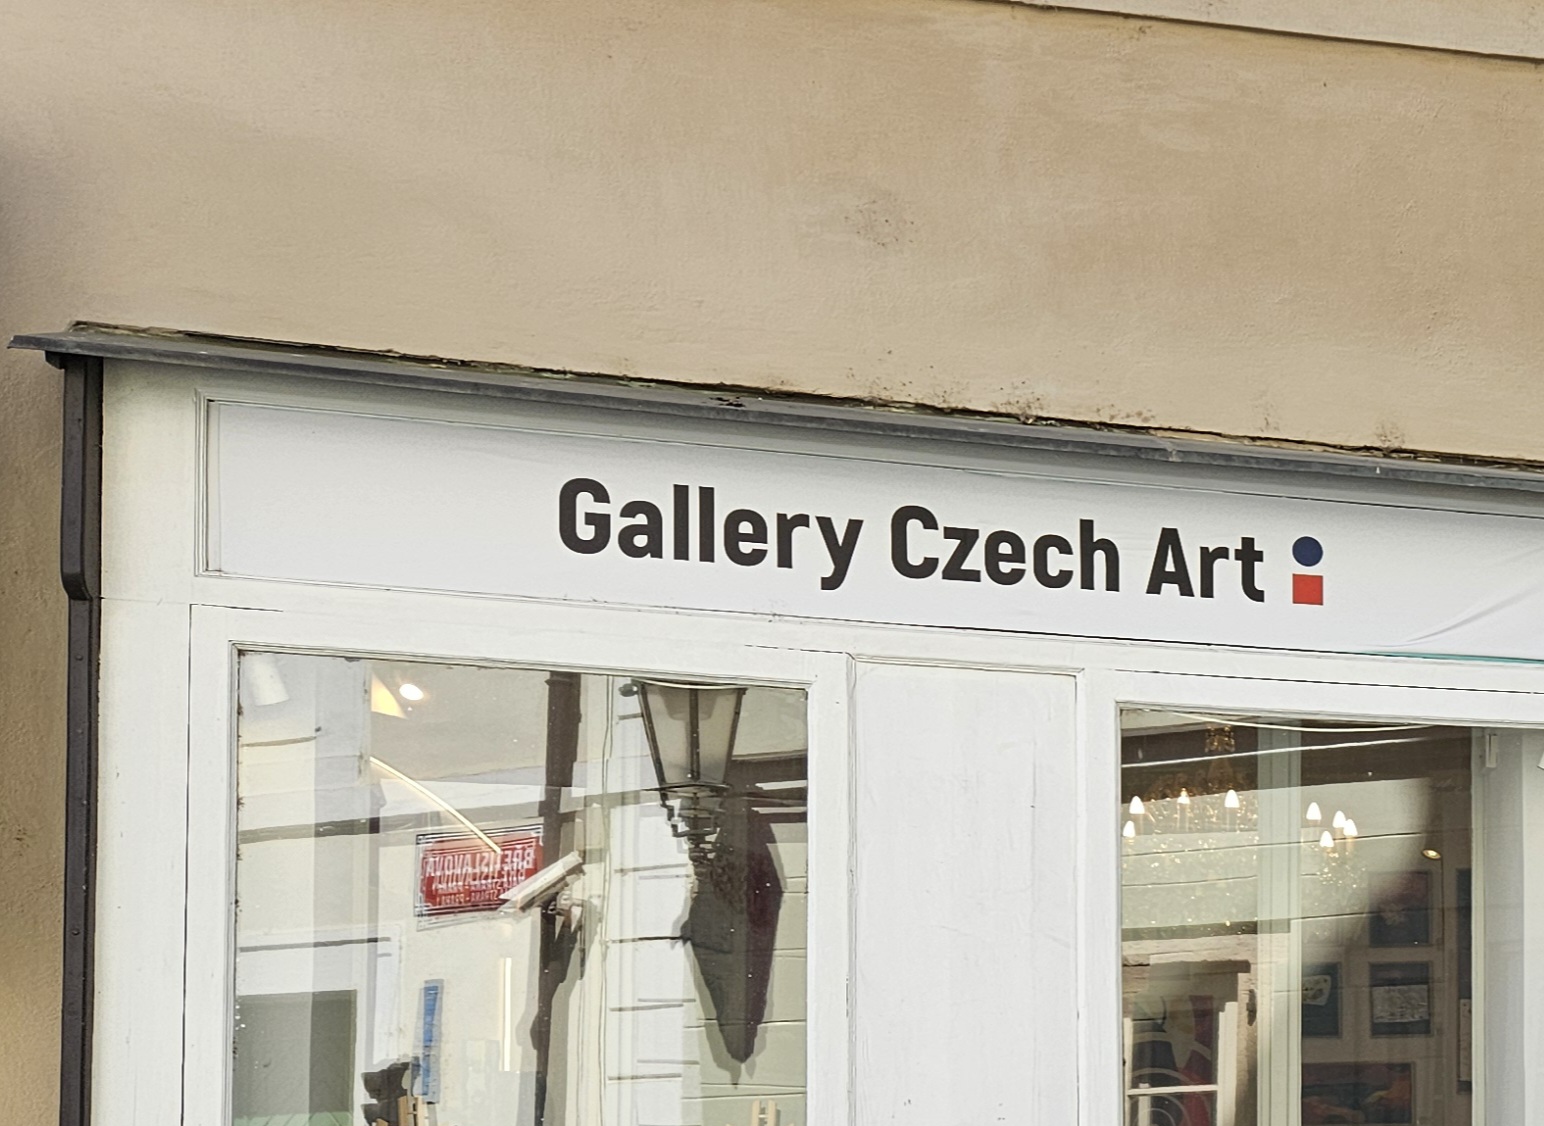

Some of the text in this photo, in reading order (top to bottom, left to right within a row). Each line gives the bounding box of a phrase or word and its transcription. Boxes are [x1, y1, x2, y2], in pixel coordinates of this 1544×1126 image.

[559, 477, 1265, 606] Gallery Czech Art
